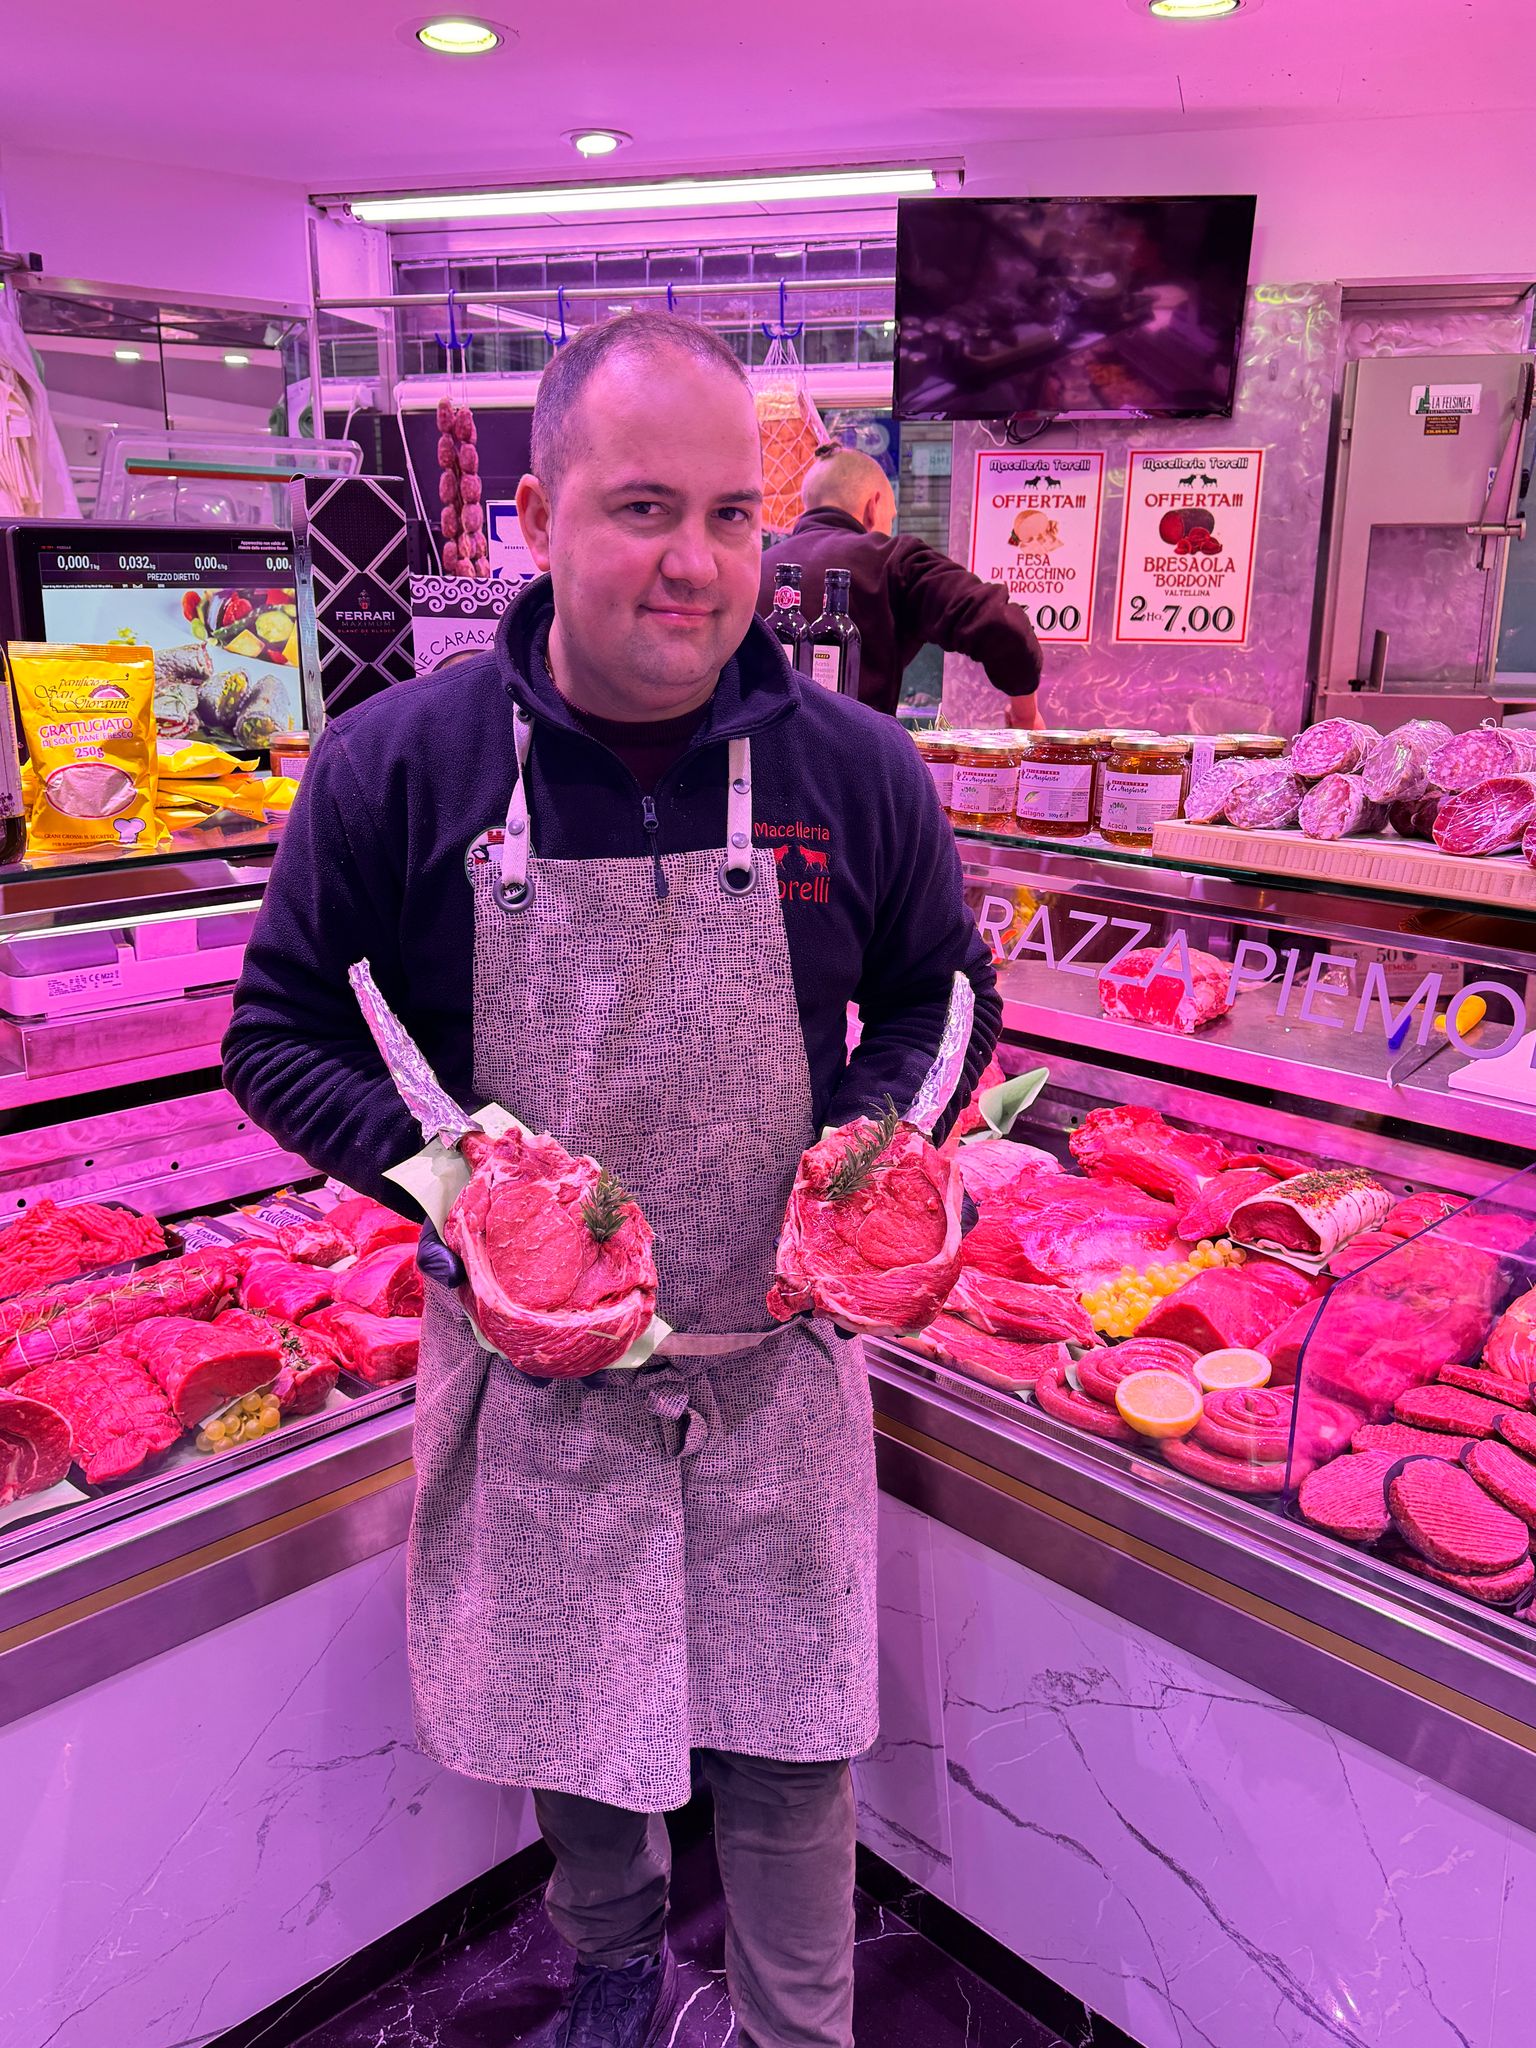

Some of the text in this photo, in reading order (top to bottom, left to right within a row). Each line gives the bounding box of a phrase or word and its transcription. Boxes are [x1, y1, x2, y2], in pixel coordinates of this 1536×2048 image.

[990, 459, 1091, 473] Macelleria Torelli
[1142, 457, 1249, 472] Macelleria Torelli
[57, 555, 90, 570] 0,000
[119, 555, 150, 571] 0,032
[194, 556, 217, 571] 0,00
[266, 557, 289, 571] 0,00
[1016, 553, 1051, 567] FESA
[1143, 557, 1236, 573] BRESAOLA
[147, 572, 200, 581] PREZZO DIRETTO
[990, 567, 1076, 580] DI TACCHINO
[1164, 589, 1211, 597] VALTELLINA
[335, 611, 395, 621] FERRARI
[1020, 604, 1081, 632] ,00
[1130, 595, 1148, 622] 2
[1162, 605, 1236, 633] 7,00
[430, 629, 495, 656] CARASA
[59, 676, 100, 689] panificio
[34, 685, 74, 699] San
[64, 695, 130, 712] Giovanni
[39, 717, 133, 739] GRATTUGIATO
[54, 736, 77, 746] SOLO
[79, 734, 100, 743] PANE
[103, 731, 134, 741] FRESCO
[75, 746, 105, 759] 250g
[1020, 809, 1045, 817] Castagno
[753, 821, 830, 841] Macelleria
[1107, 822, 1128, 830] Acacia
[778, 876, 831, 904] orelli
[976, 895, 1536, 1069] RAZZA PIEMO
